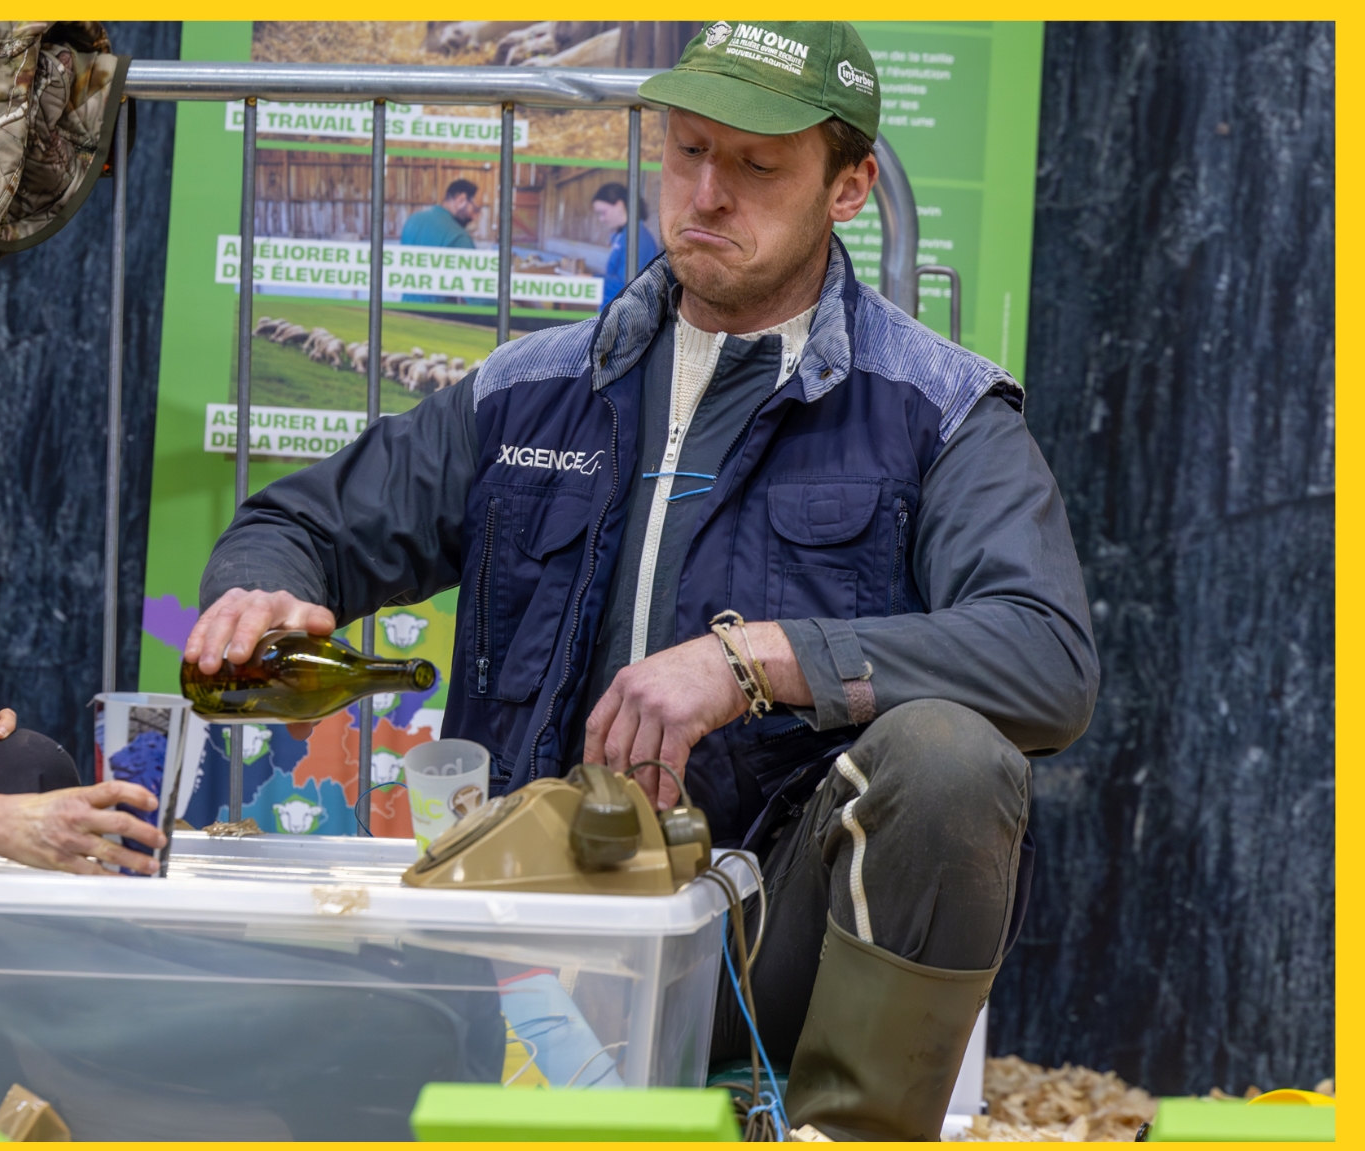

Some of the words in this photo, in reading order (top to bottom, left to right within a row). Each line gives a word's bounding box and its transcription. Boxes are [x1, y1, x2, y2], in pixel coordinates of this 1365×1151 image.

[734, 23, 810, 59] INN'OVIN
[726, 47, 802, 76] NOUVELLE-AQUITAINE
[843, 66, 874, 88] interbev
[267, 113, 356, 132] TRAVAIL
[223, 240, 349, 263] AÉLIORER
[361, 245, 393, 265] LS
[400, 251, 500, 272] REVENUS
[222, 263, 264, 280] DS
[271, 261, 372, 286] ÉLEVEUR
[388, 273, 431, 290] PAR
[439, 276, 465, 291] LA
[472, 277, 596, 299] TEHNIQUE
[323, 417, 349, 433] LA
[496, 444, 586, 470] XIGENCE
